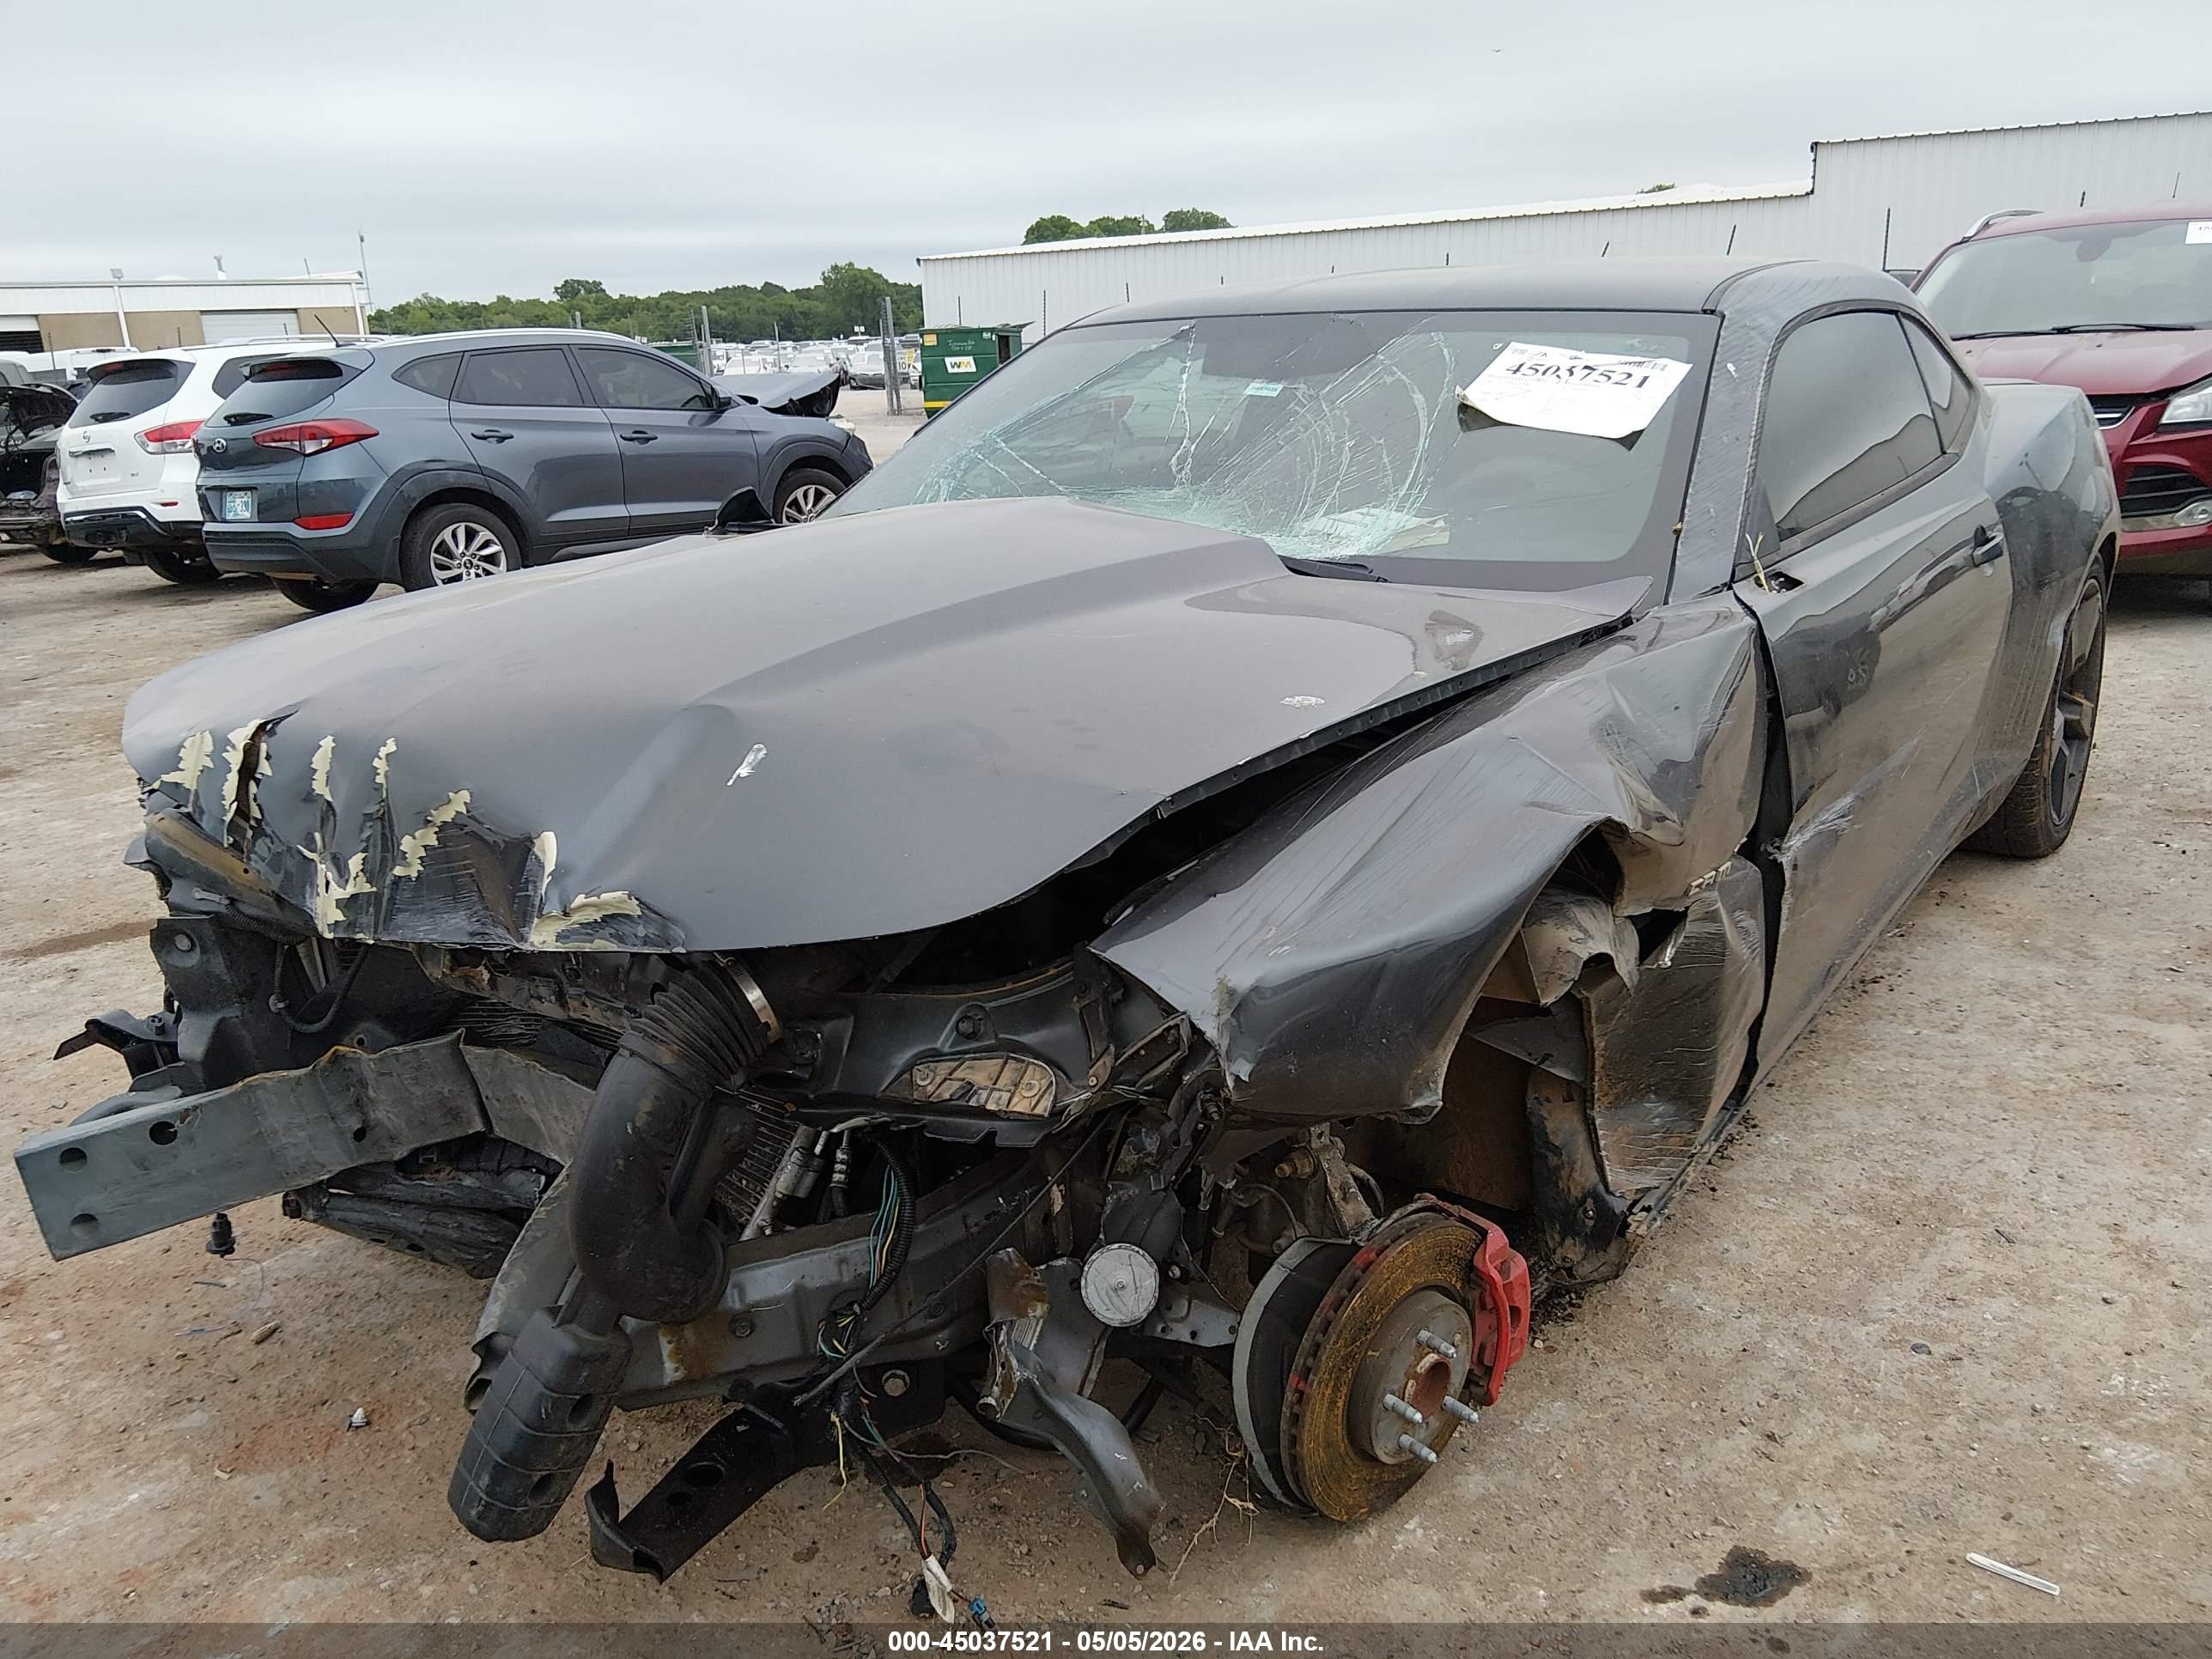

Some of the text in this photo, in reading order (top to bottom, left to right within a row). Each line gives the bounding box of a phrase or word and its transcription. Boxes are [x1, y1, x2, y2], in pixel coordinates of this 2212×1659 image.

[898, 361, 907, 370] 10
[950, 361, 971, 369] WM
[1505, 362, 1650, 388] 45037521
